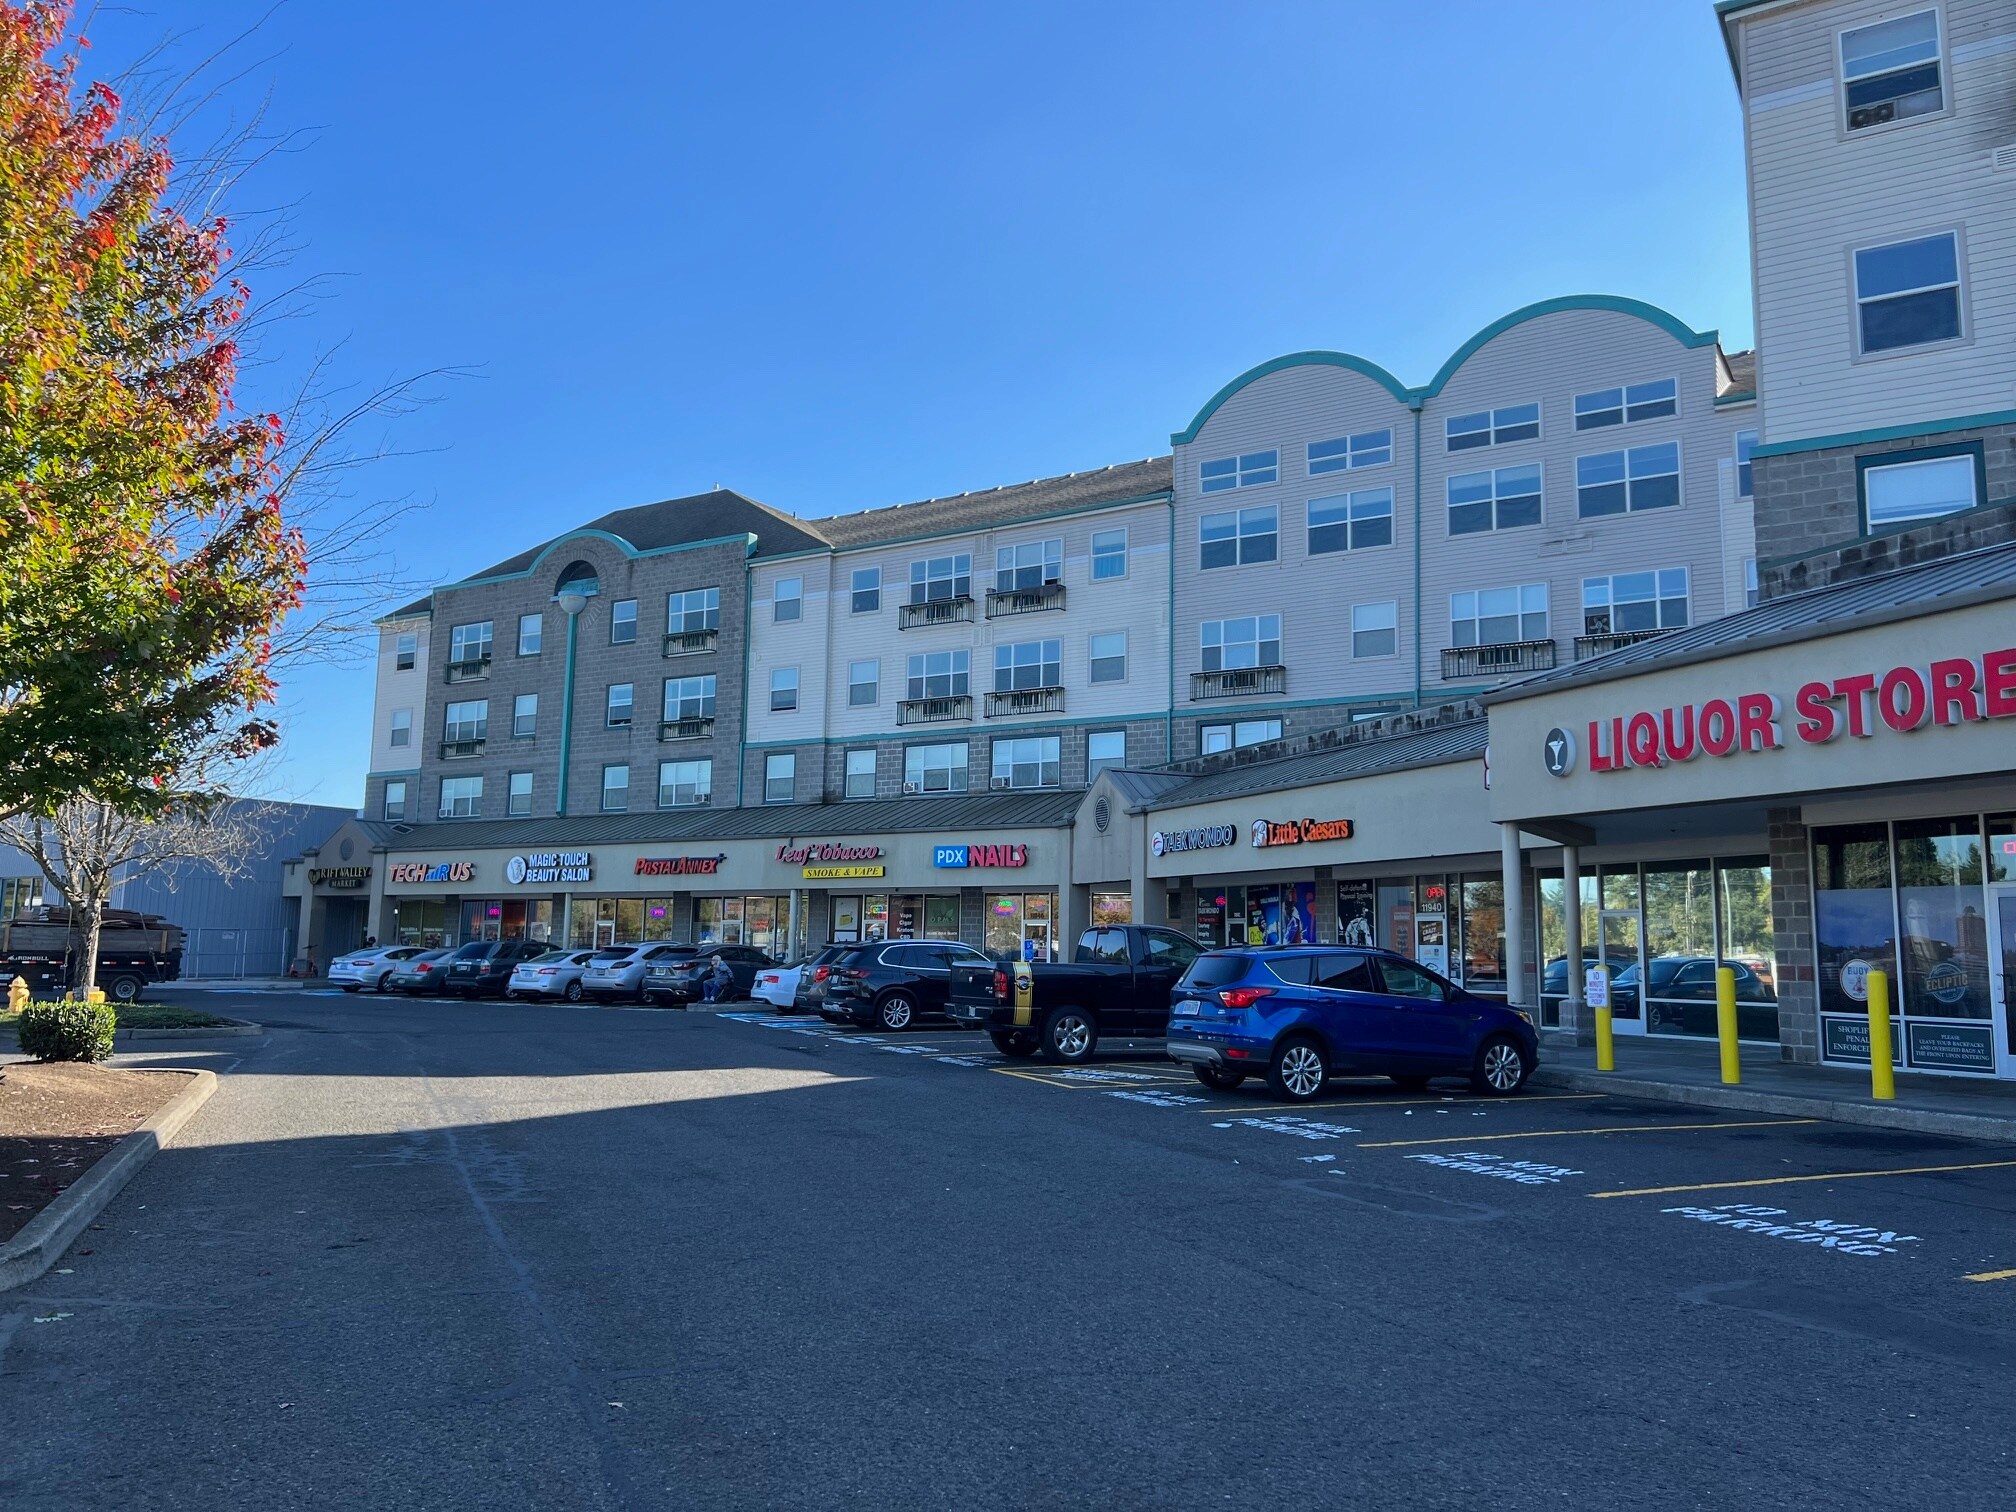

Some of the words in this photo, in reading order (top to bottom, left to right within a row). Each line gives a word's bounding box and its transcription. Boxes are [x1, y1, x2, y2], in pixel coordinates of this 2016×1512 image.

[1588, 692, 1782, 773] LIQUOR
[1796, 648, 2016, 744] STORE
[1268, 821, 1299, 845] Little
[1301, 818, 1348, 842] Caesars
[529, 854, 557, 866] MAGIC
[559, 852, 588, 866] TOUCH
[775, 846, 811, 866] Leaf
[814, 843, 879, 860] Tobacco
[937, 850, 964, 863] PDX
[970, 844, 1027, 867] NAILS
[321, 868, 338, 878] RIFT
[340, 866, 368, 878] VALLEY
[389, 864, 427, 882] TECH
[450, 862, 472, 881] US
[526, 869, 559, 882] BEAUTY
[561, 868, 590, 881] SALON
[807, 869, 840, 877] SMOKE
[843, 868, 851, 876] &
[854, 867, 879, 875] VAPE
[332, 880, 356, 888] MARKET
[1593, 972, 1600, 980] 10
[1926, 973, 1969, 991] ECLIPTIC
[1838, 1026, 1870, 1034] SHOPLIF
[1846, 1035, 1870, 1043] PENAL
[1660, 1206, 1898, 1256] PARKING
[1711, 1204, 1788, 1216] 10
[1794, 1219, 1920, 1243] MIN
